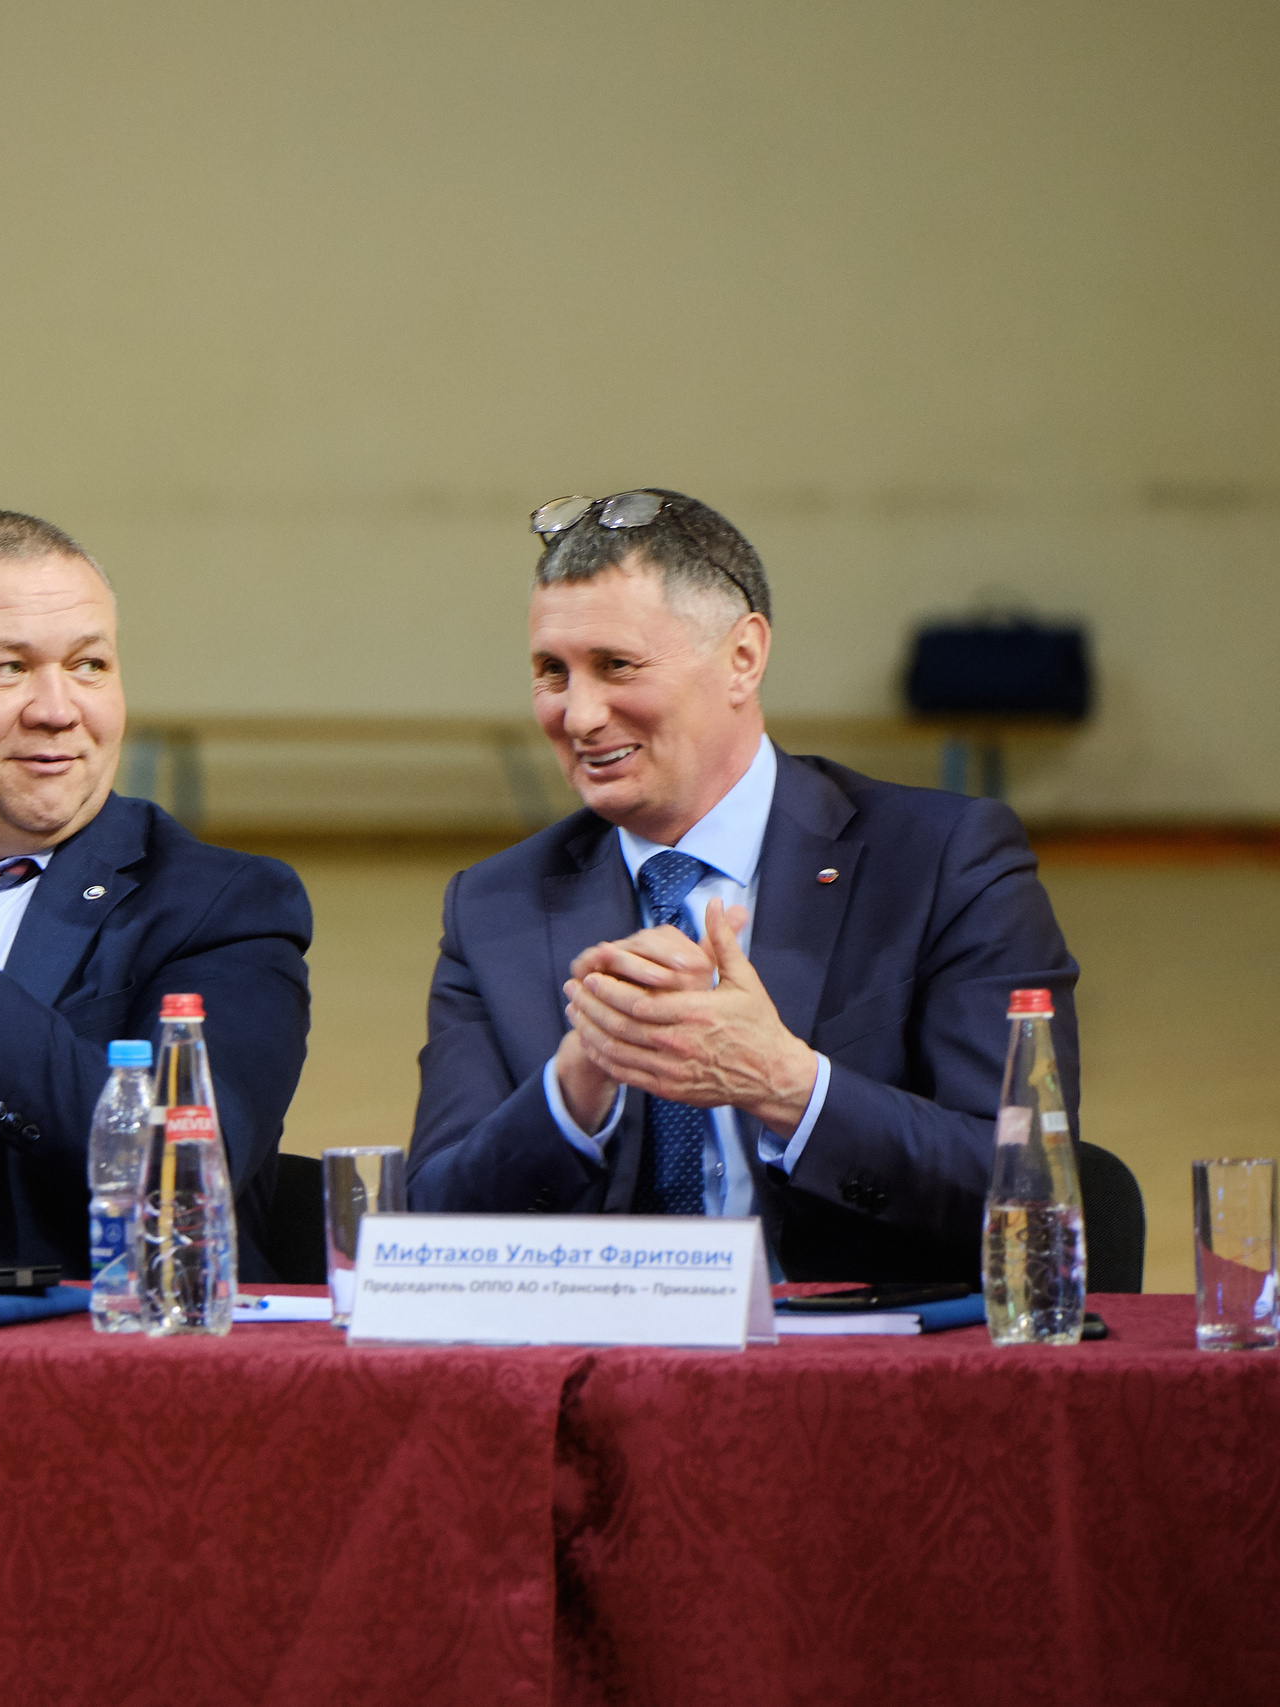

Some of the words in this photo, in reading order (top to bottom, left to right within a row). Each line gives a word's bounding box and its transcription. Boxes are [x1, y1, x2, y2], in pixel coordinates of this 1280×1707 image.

[375, 1243, 499, 1266] Мифтахов
[506, 1244, 593, 1267] Ульфат
[599, 1245, 733, 1267] Фаритович
[364, 1279, 466, 1294] Председатель
[470, 1280, 513, 1293] ОППО
[517, 1281, 539, 1293] АО
[543, 1281, 637, 1296] «Транснефть
[652, 1282, 738, 1297] Прикамье»
